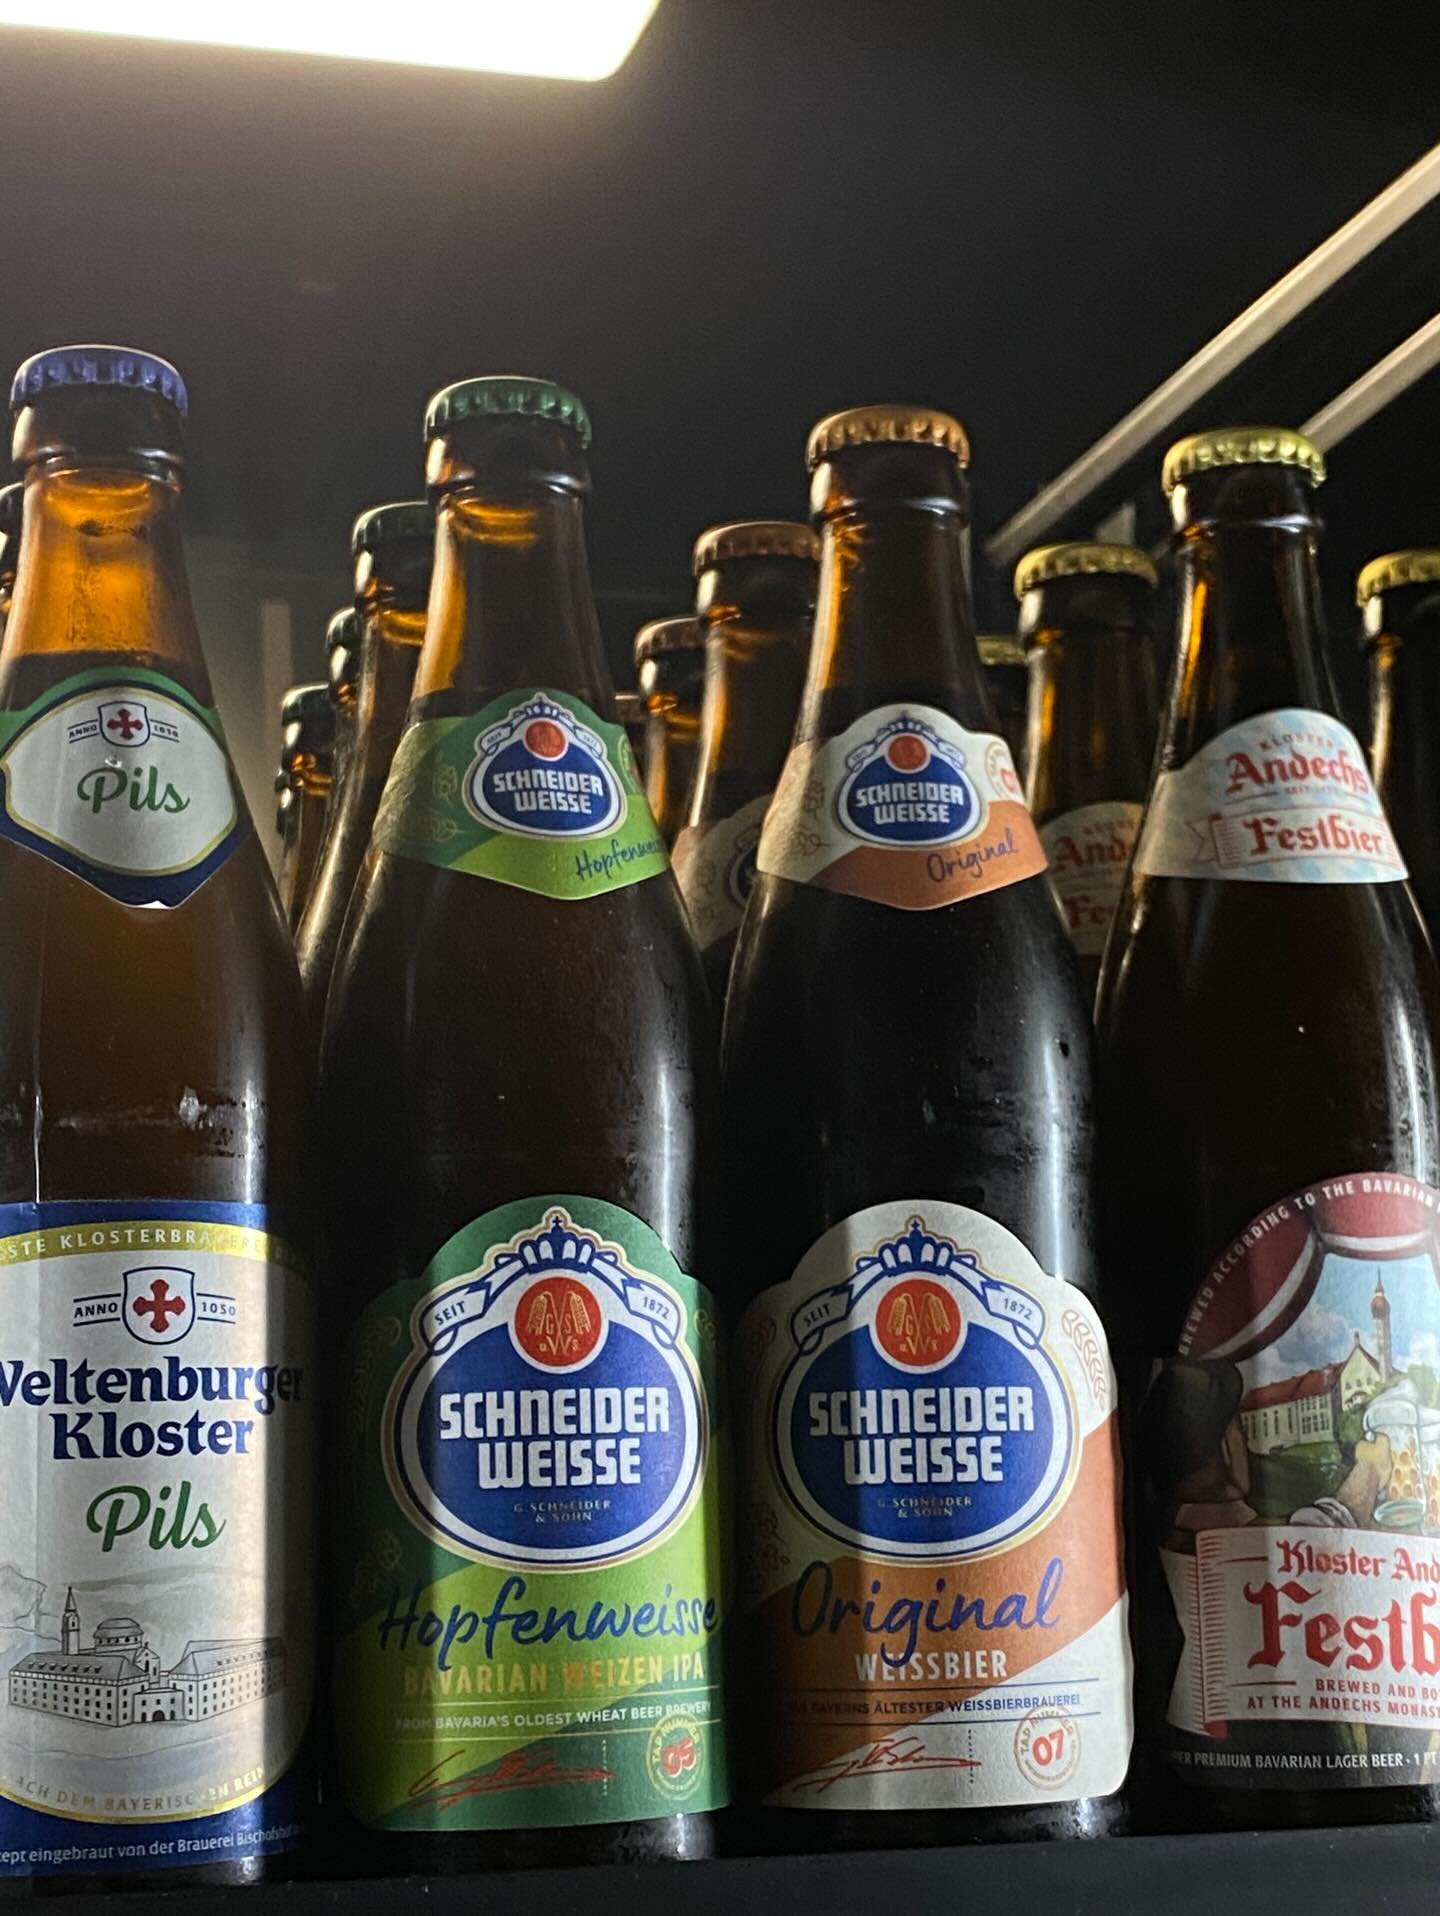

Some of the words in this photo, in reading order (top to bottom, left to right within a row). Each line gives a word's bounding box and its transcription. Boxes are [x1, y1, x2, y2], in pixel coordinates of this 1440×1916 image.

[69, 724, 97, 739] ANNO
[493, 770, 604, 798] SCHNEIDER
[1224, 746, 1370, 795] Andechs
[77, 766, 190, 813] Pils
[513, 791, 592, 814] WEISSE
[856, 782, 965, 807] SCHNEIDER
[874, 804, 951, 824] WEISSE
[1242, 814, 1383, 856] Festbier
[926, 828, 1017, 882] Original
[1177, 1286, 1214, 1355] BREWED
[1212, 1205, 1291, 1284] ACCORDING
[1294, 1191, 1316, 1211] TO
[1322, 1181, 1354, 1201] THE
[1362, 1178, 1433, 1209] BAVARIAN
[73, 1302, 118, 1318] ANNO
[201, 1301, 236, 1316] 1050
[434, 1300, 466, 1326] SEIT
[642, 1296, 671, 1320] 1872
[802, 1303, 832, 1327] SEIT
[1002, 1297, 1033, 1321] 1872
[439, 1386, 670, 1440] SCHNEIDER
[809, 1385, 1035, 1436] SCHNEIDER
[49, 1410, 255, 1460] Kloster
[478, 1437, 641, 1490] WEISSE
[843, 1436, 1004, 1485] WEISSE
[86, 1480, 227, 1553] Pils
[530, 1499, 612, 1513] SCHNEIDER
[892, 1496, 973, 1508] SCHNEIDER
[897, 1508, 908, 1519] &
[913, 1507, 953, 1518] SOHN
[535, 1514, 545, 1524] &
[552, 1511, 592, 1522] SOHN
[1276, 1539, 1387, 1577] Kloster
[378, 1575, 717, 1672] Hopfenweisse
[791, 1557, 1064, 1668] Original
[404, 1663, 548, 1696] BAVARIAN
[563, 1655, 663, 1691] WEIZEN
[672, 1651, 705, 1682] IPA
[855, 1649, 1008, 1682] WEISSBIER
[1316, 1679, 1381, 1695] BREWED
[1388, 1683, 1416, 1698] AND
[394, 1718, 434, 1730] FROM
[435, 1714, 510, 1729] BAVARIA'S
[513, 1712, 572, 1727] OLDEST
[576, 1708, 627, 1723] WHEAT
[631, 1705, 663, 1720] BEER
[873, 1700, 945, 1714] ÄLTESTER
[949, 1694, 1081, 1713] WEISSBIERBRAUEREI
[1247, 1696, 1264, 1710] AT
[1271, 1695, 1301, 1709] THE
[1309, 1695, 1381, 1713] ANDECHS
[1020, 1727, 1031, 1755] TAP
[1032, 1728, 1065, 1767] 07
[1194, 1752, 1252, 1768] PREMIUM
[1255, 1753, 1322, 1769] BAVARIAN
[1326, 1754, 1368, 1769] LAGER
[1371, 1752, 1404, 1767] BEER
[1413, 1752, 1420, 1766] 1
[56, 1790, 96, 1808] DEM
[28, 1846, 114, 1865] eingebraut
[118, 1844, 146, 1858] von
[149, 1840, 174, 1855] der
[177, 1834, 234, 1853] Brauerei
